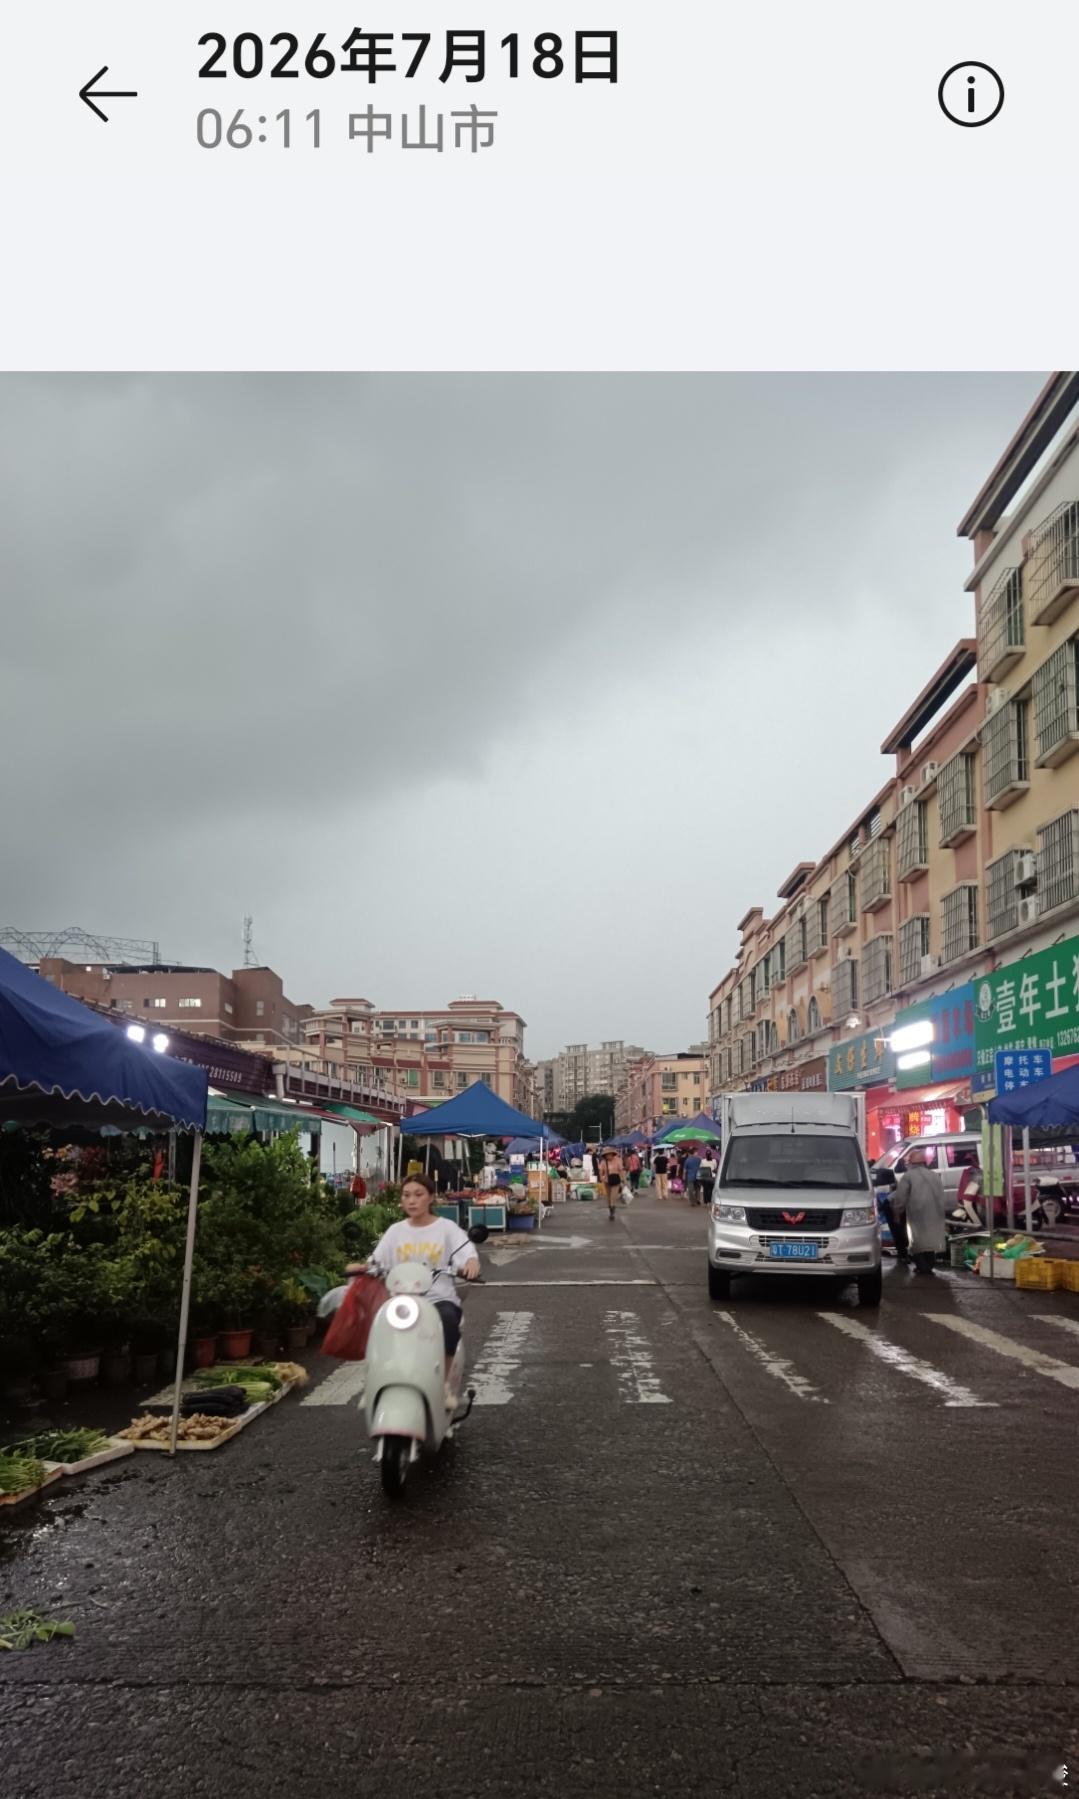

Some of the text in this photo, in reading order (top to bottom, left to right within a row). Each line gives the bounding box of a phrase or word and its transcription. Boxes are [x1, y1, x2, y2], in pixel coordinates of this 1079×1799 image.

[1004, 1055, 1044, 1066] 摩托车
[1004, 1067, 1044, 1078] 电动车
